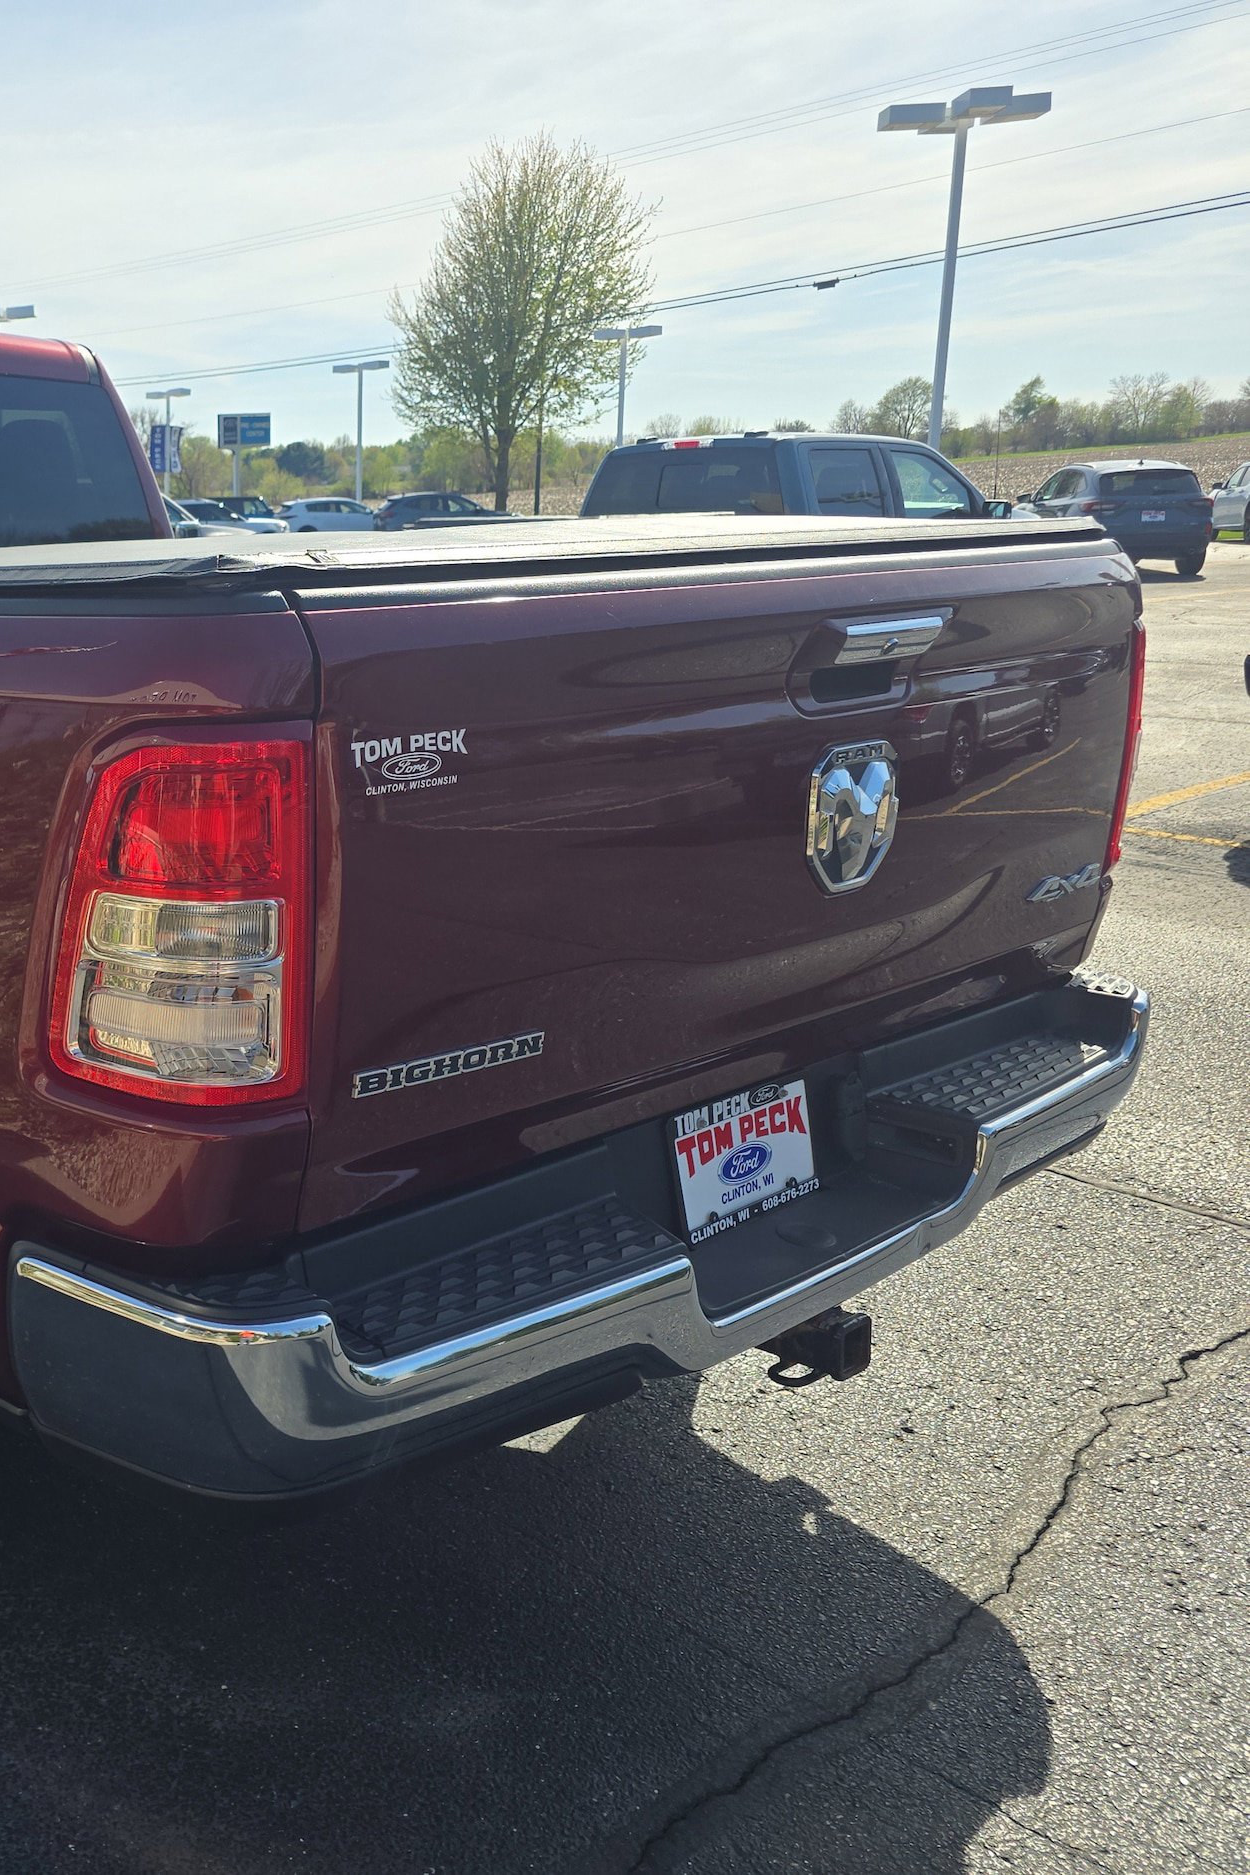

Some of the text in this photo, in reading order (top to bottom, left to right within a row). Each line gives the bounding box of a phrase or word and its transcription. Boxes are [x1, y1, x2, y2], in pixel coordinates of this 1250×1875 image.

[350, 728, 469, 769] TOM PECK
[394, 757, 430, 775] Ford
[835, 743, 886, 764] RAM
[365, 774, 458, 797] CLINTON, WISCONSIN
[351, 1030, 546, 1099] BIGHORN
[673, 1086, 775, 1138] TOM PECK Ford
[676, 1095, 808, 1179] TOM PECK
[729, 1149, 761, 1178] Ford
[721, 1172, 775, 1205] CLINTON, WI
[690, 1215, 737, 1244] CLINTON,
[737, 1207, 751, 1224] WI
[761, 1177, 820, 1213] 608-676-2273
